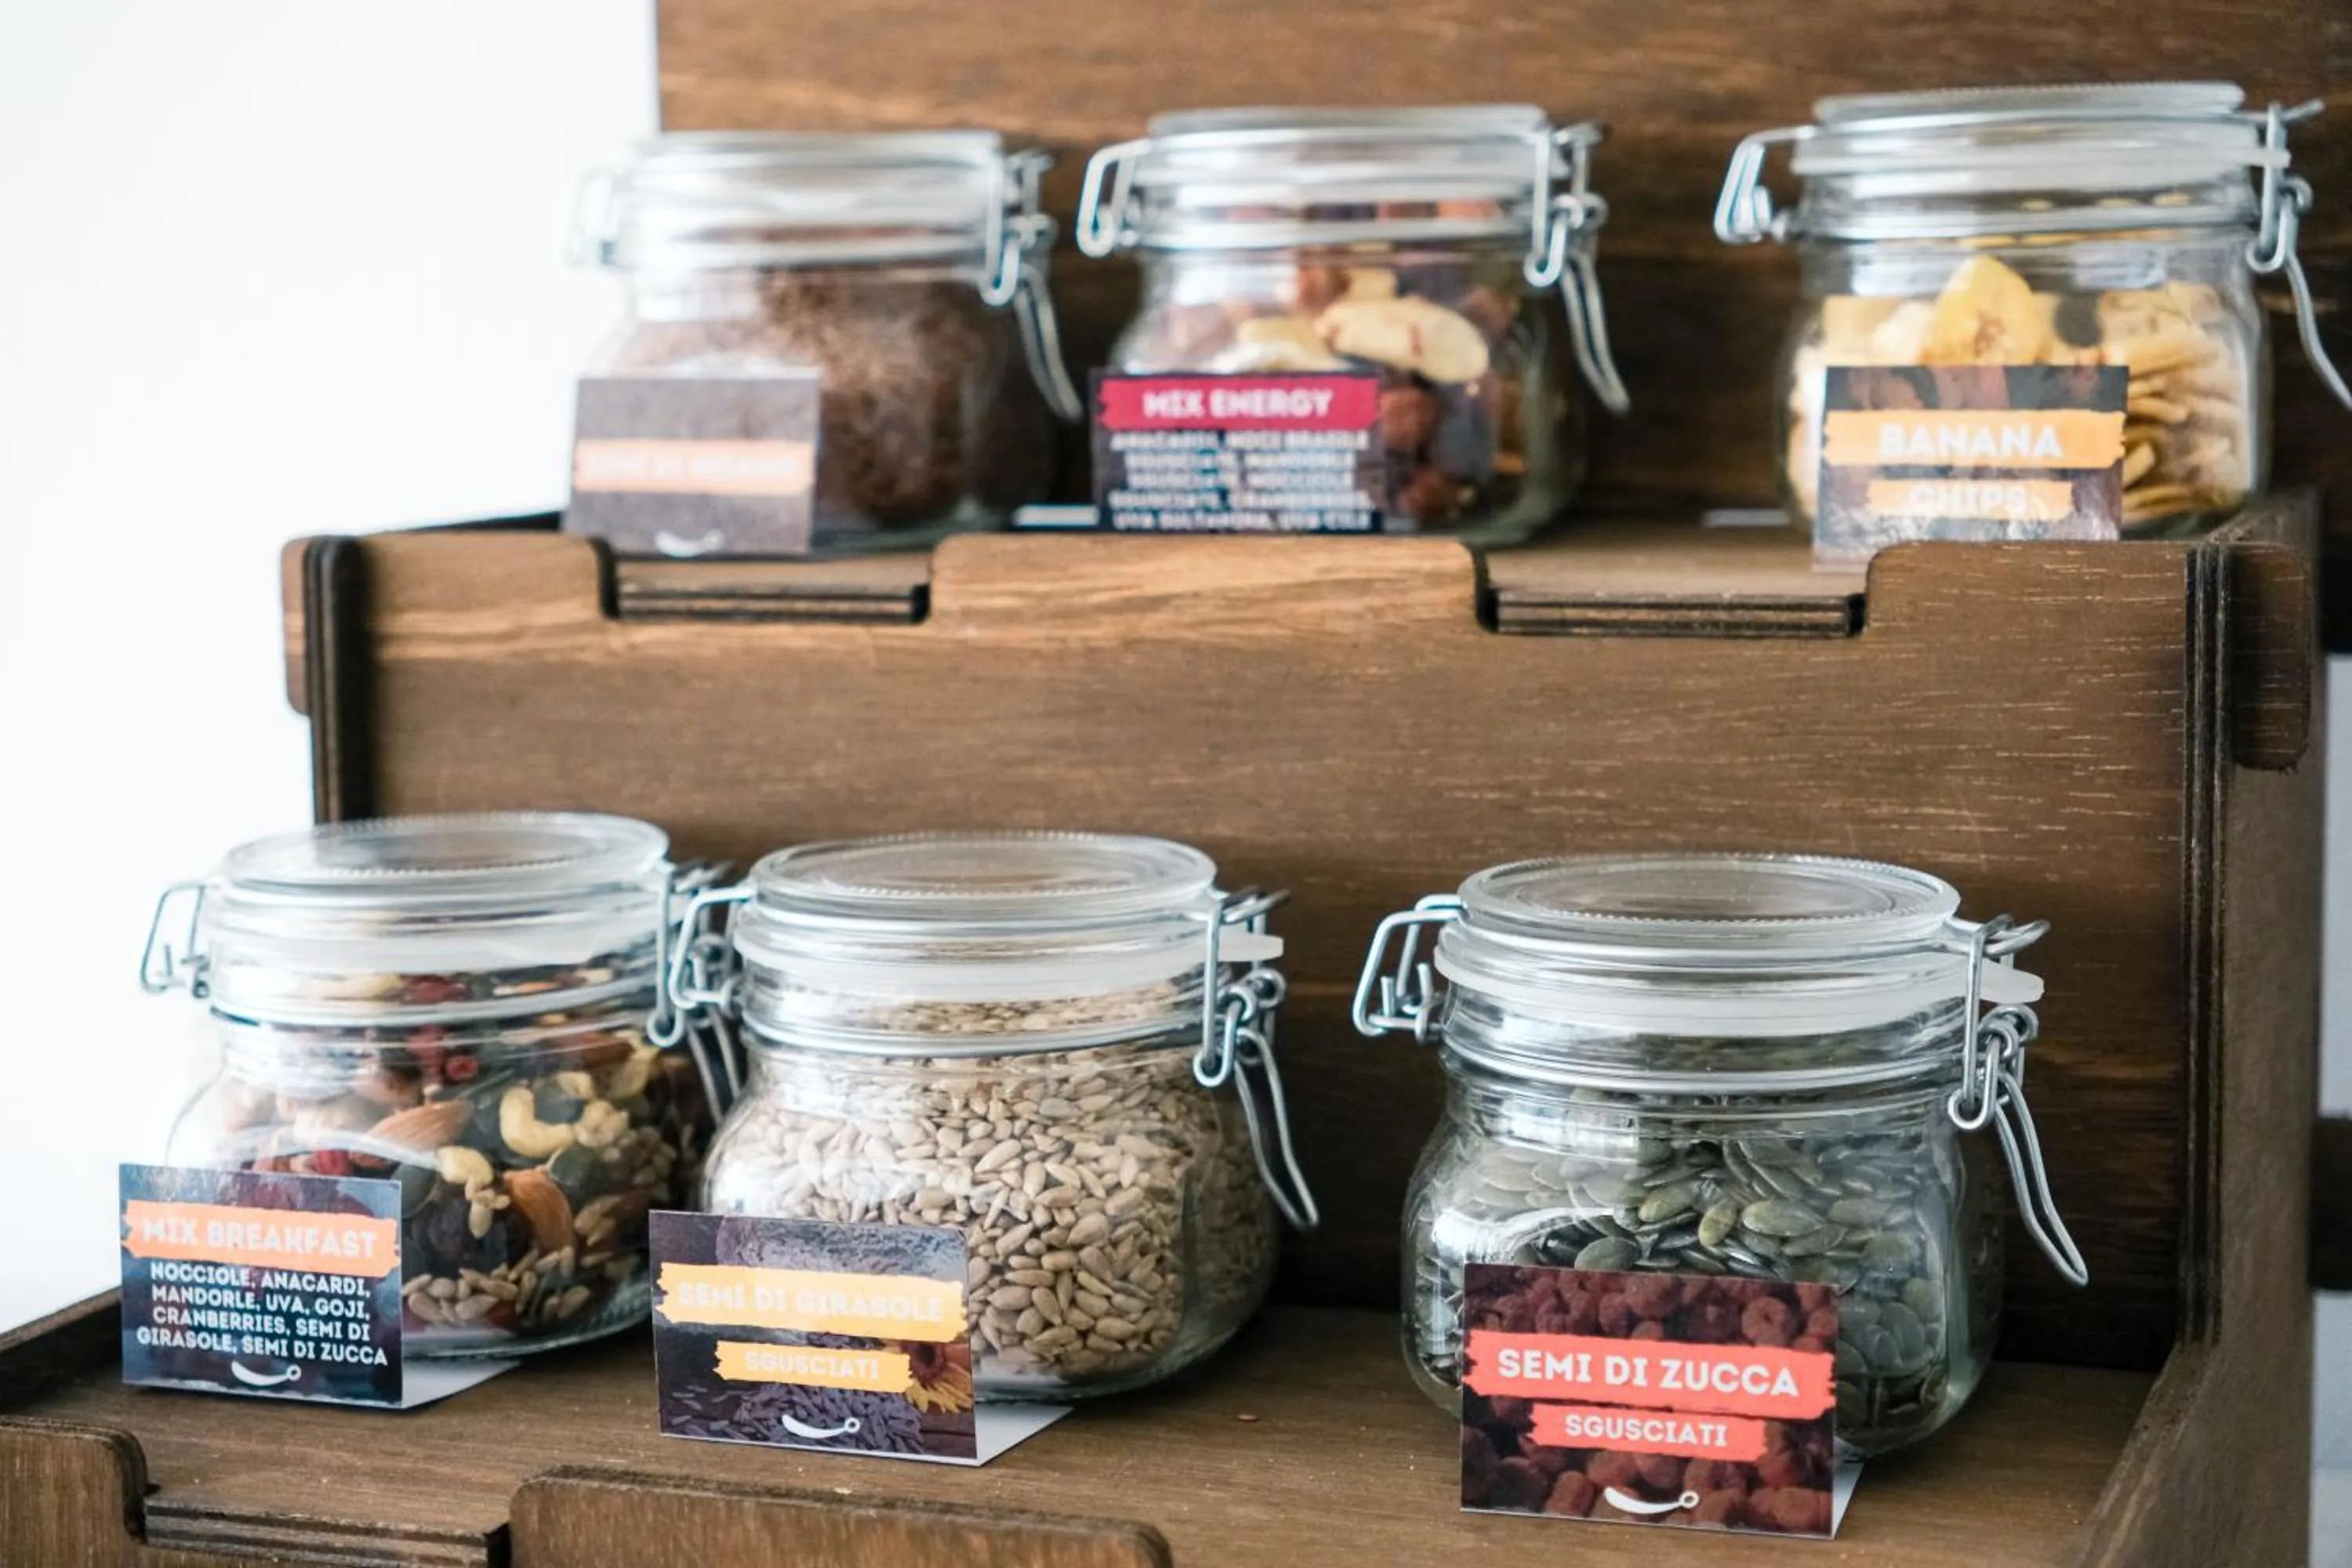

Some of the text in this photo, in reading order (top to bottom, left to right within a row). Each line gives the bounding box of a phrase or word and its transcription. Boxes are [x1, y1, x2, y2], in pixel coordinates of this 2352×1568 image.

[1142, 388, 1334, 418] MIX ENERGY
[1879, 423, 2063, 459] BANANA
[1909, 482, 2027, 514] CHIPS
[143, 1218, 377, 1259] MIX BREAKFAST
[151, 1262, 371, 1298] NOCCIOLE, ANACARDI,
[152, 1286, 370, 1320] MANDORLE, UVA, GOJI,
[677, 1280, 943, 1322] SEMI DI GIRASOLE
[153, 1306, 370, 1342] CRANBERRIES, SEMI DI
[136, 1327, 388, 1367] GIRASOLE, SEMI DI ZUCCA
[744, 1350, 879, 1381] SGUSCIATI
[1497, 1348, 1799, 1397] SEMI DI ZUCCA
[1565, 1414, 1727, 1447] SGUSCIATI
